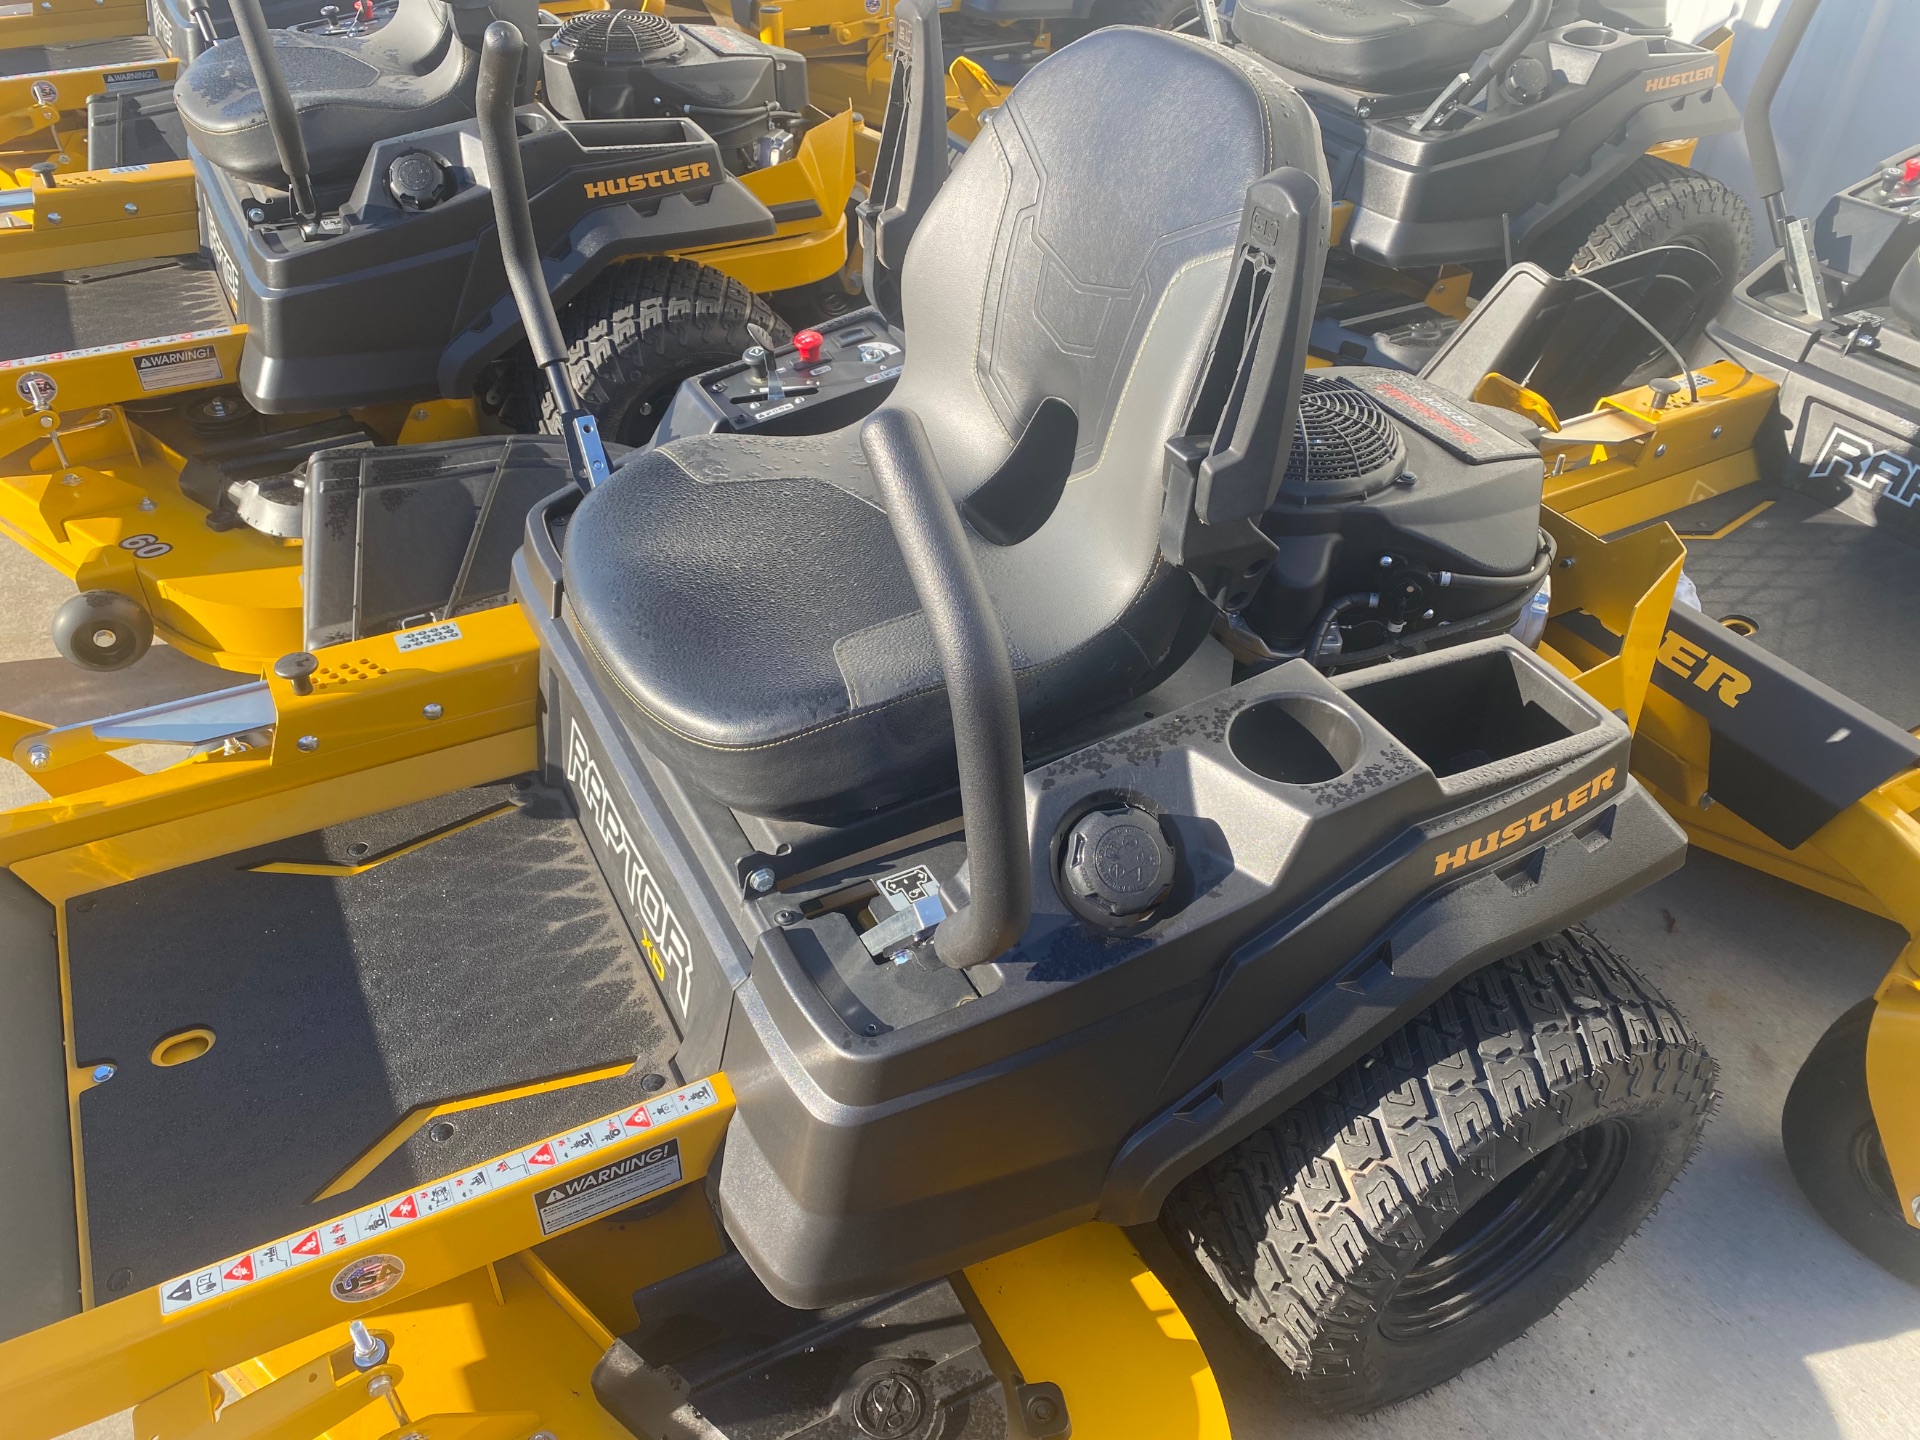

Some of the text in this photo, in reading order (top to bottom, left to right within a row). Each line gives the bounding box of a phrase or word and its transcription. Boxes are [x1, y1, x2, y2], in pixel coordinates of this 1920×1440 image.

[114, 70, 154, 81] WARNING!
[1645, 65, 1715, 92] HUSTLER
[583, 162, 711, 199] HUSTLER
[150, 347, 211, 366] WARNING!
[119, 534, 173, 559] 60
[1433, 766, 1616, 877] HUSTLER
[567, 716, 694, 1019] RAPTOR
[641, 927, 665, 982] XD
[565, 1144, 670, 1196] WARNING!
[335, 1263, 402, 1295] USA
